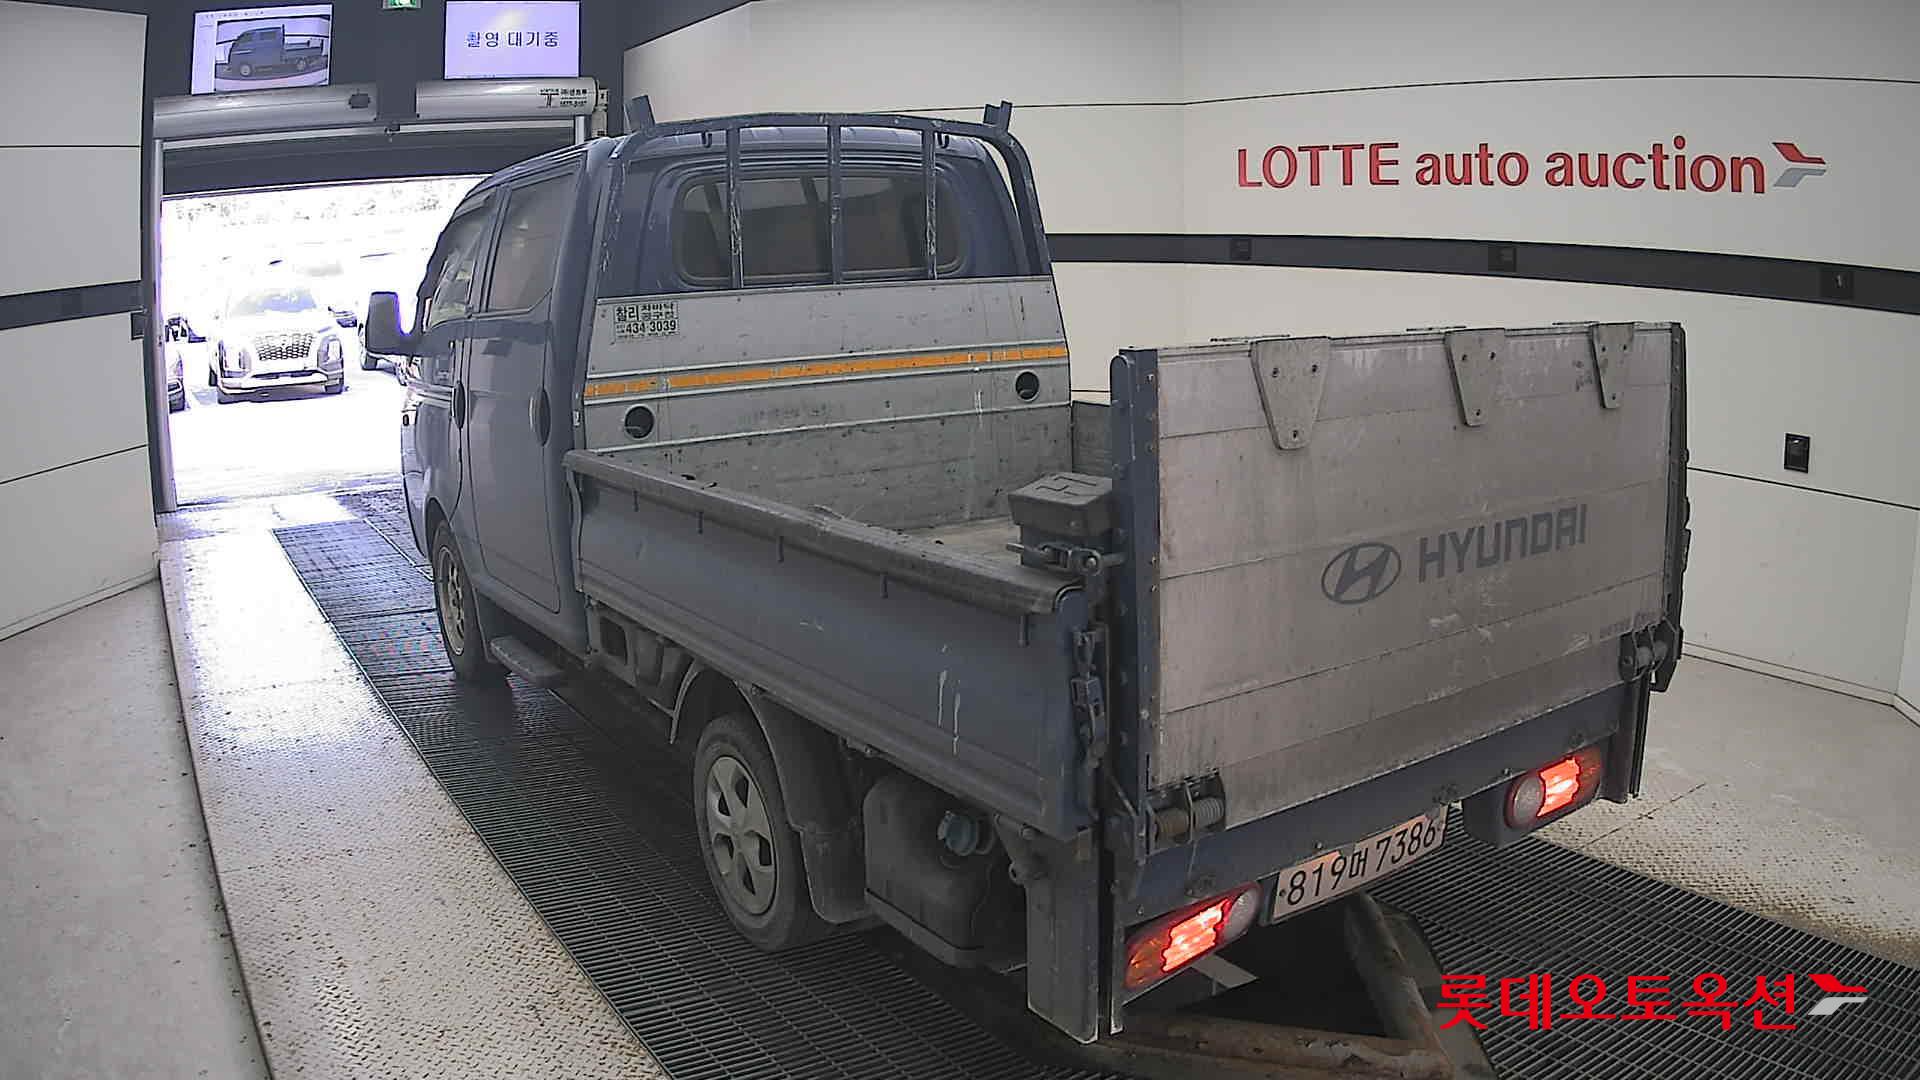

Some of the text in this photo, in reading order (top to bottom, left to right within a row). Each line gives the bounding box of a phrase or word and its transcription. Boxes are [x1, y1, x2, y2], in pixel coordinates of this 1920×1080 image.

[508, 31, 559, 48] 대기중
[1237, 135, 1765, 194] LOTTE auto auction
[1417, 503, 1588, 583] HYUNDAI
